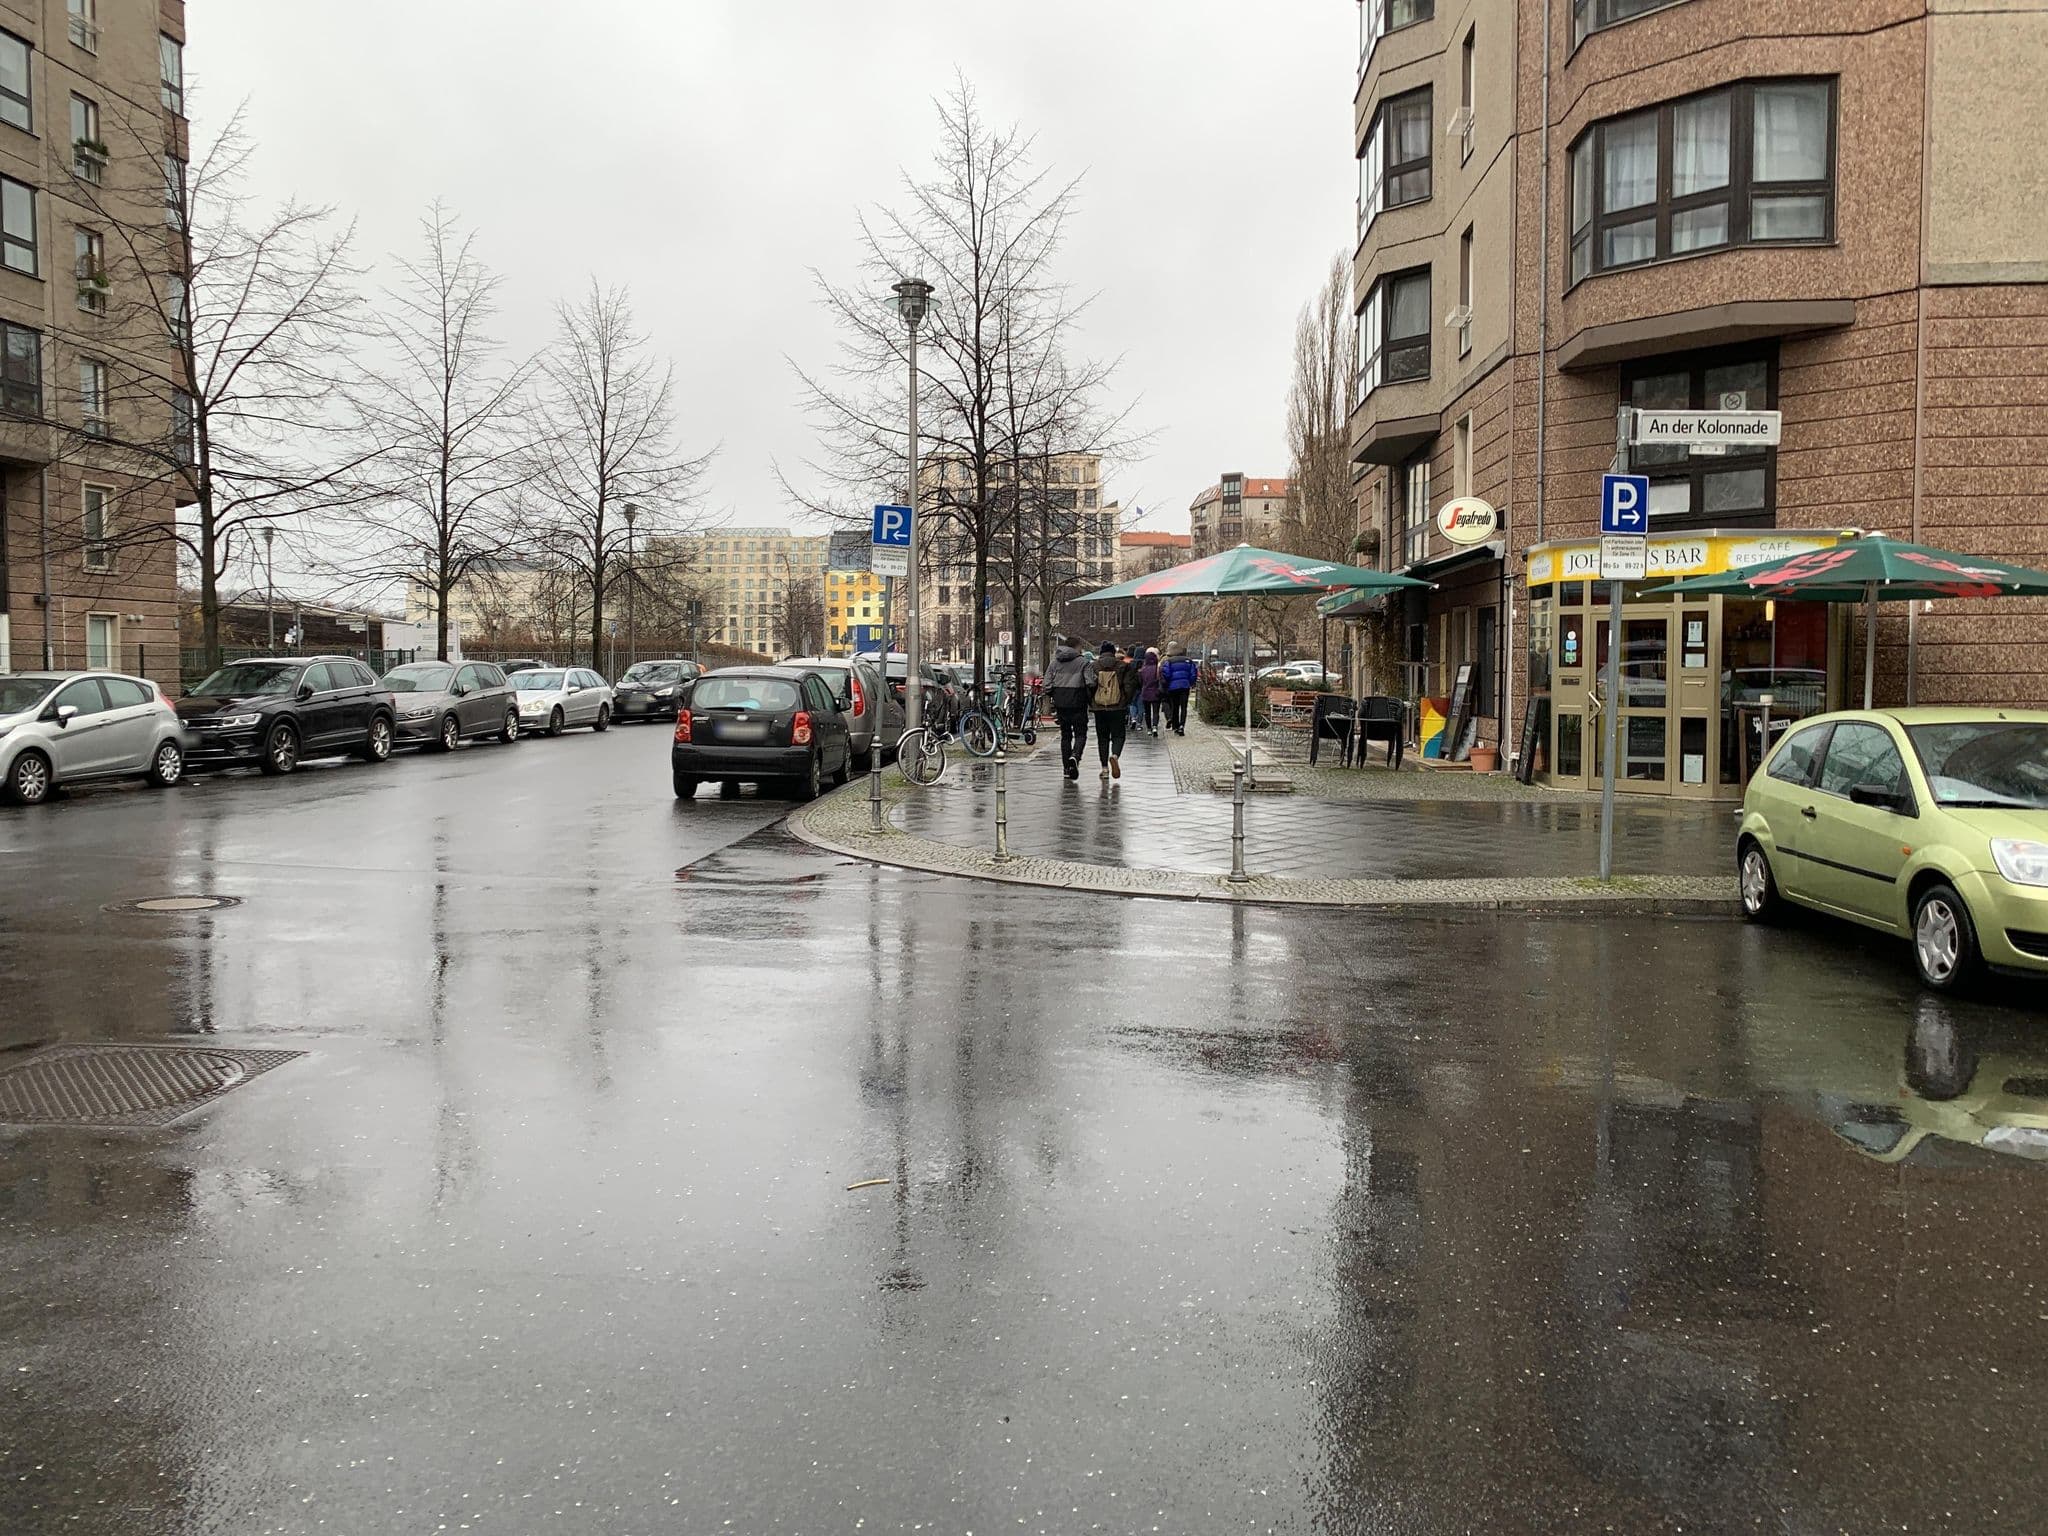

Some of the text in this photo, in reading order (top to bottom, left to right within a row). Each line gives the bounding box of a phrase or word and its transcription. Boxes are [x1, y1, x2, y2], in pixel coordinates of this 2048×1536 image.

[1649, 418, 1769, 435] An der Kolonnade
[1612, 482, 1638, 526] P
[881, 510, 903, 539] P
[1445, 507, 1492, 529] Segafredo
[1665, 547, 1702, 564] BAR
[1759, 541, 1791, 551] CAFÉ
